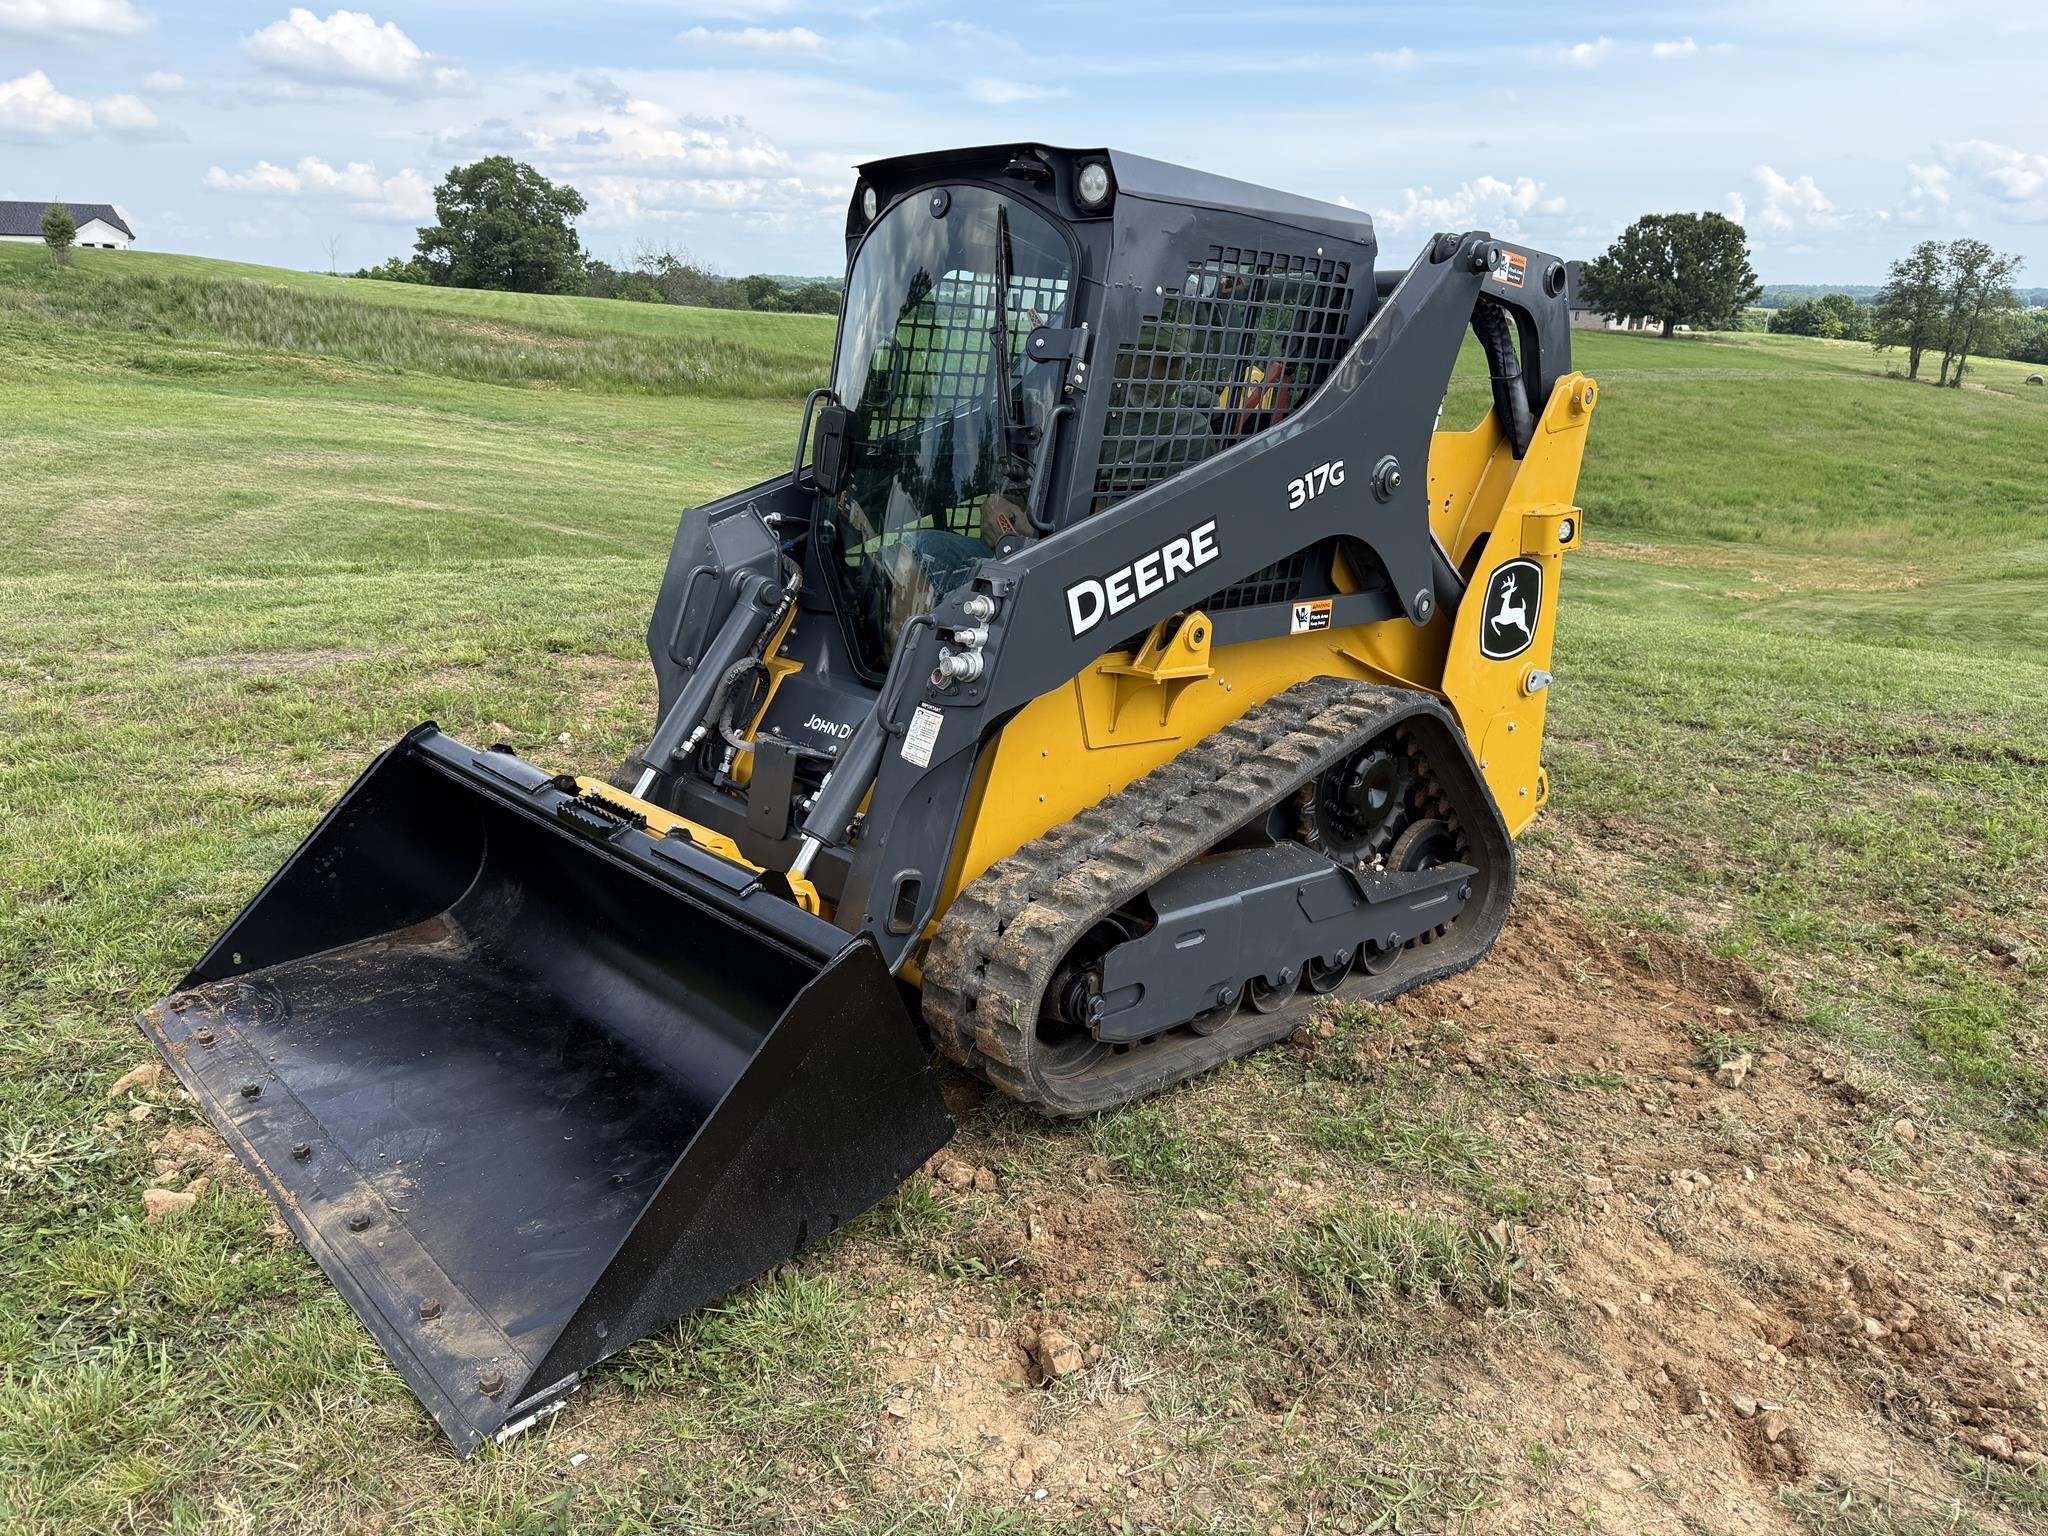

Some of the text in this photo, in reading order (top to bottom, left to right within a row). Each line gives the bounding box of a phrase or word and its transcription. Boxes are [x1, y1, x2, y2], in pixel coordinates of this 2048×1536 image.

[1287, 460, 1345, 510] 317G
[1066, 519, 1219, 636] DEERE
[803, 713, 839, 736] JOHN
